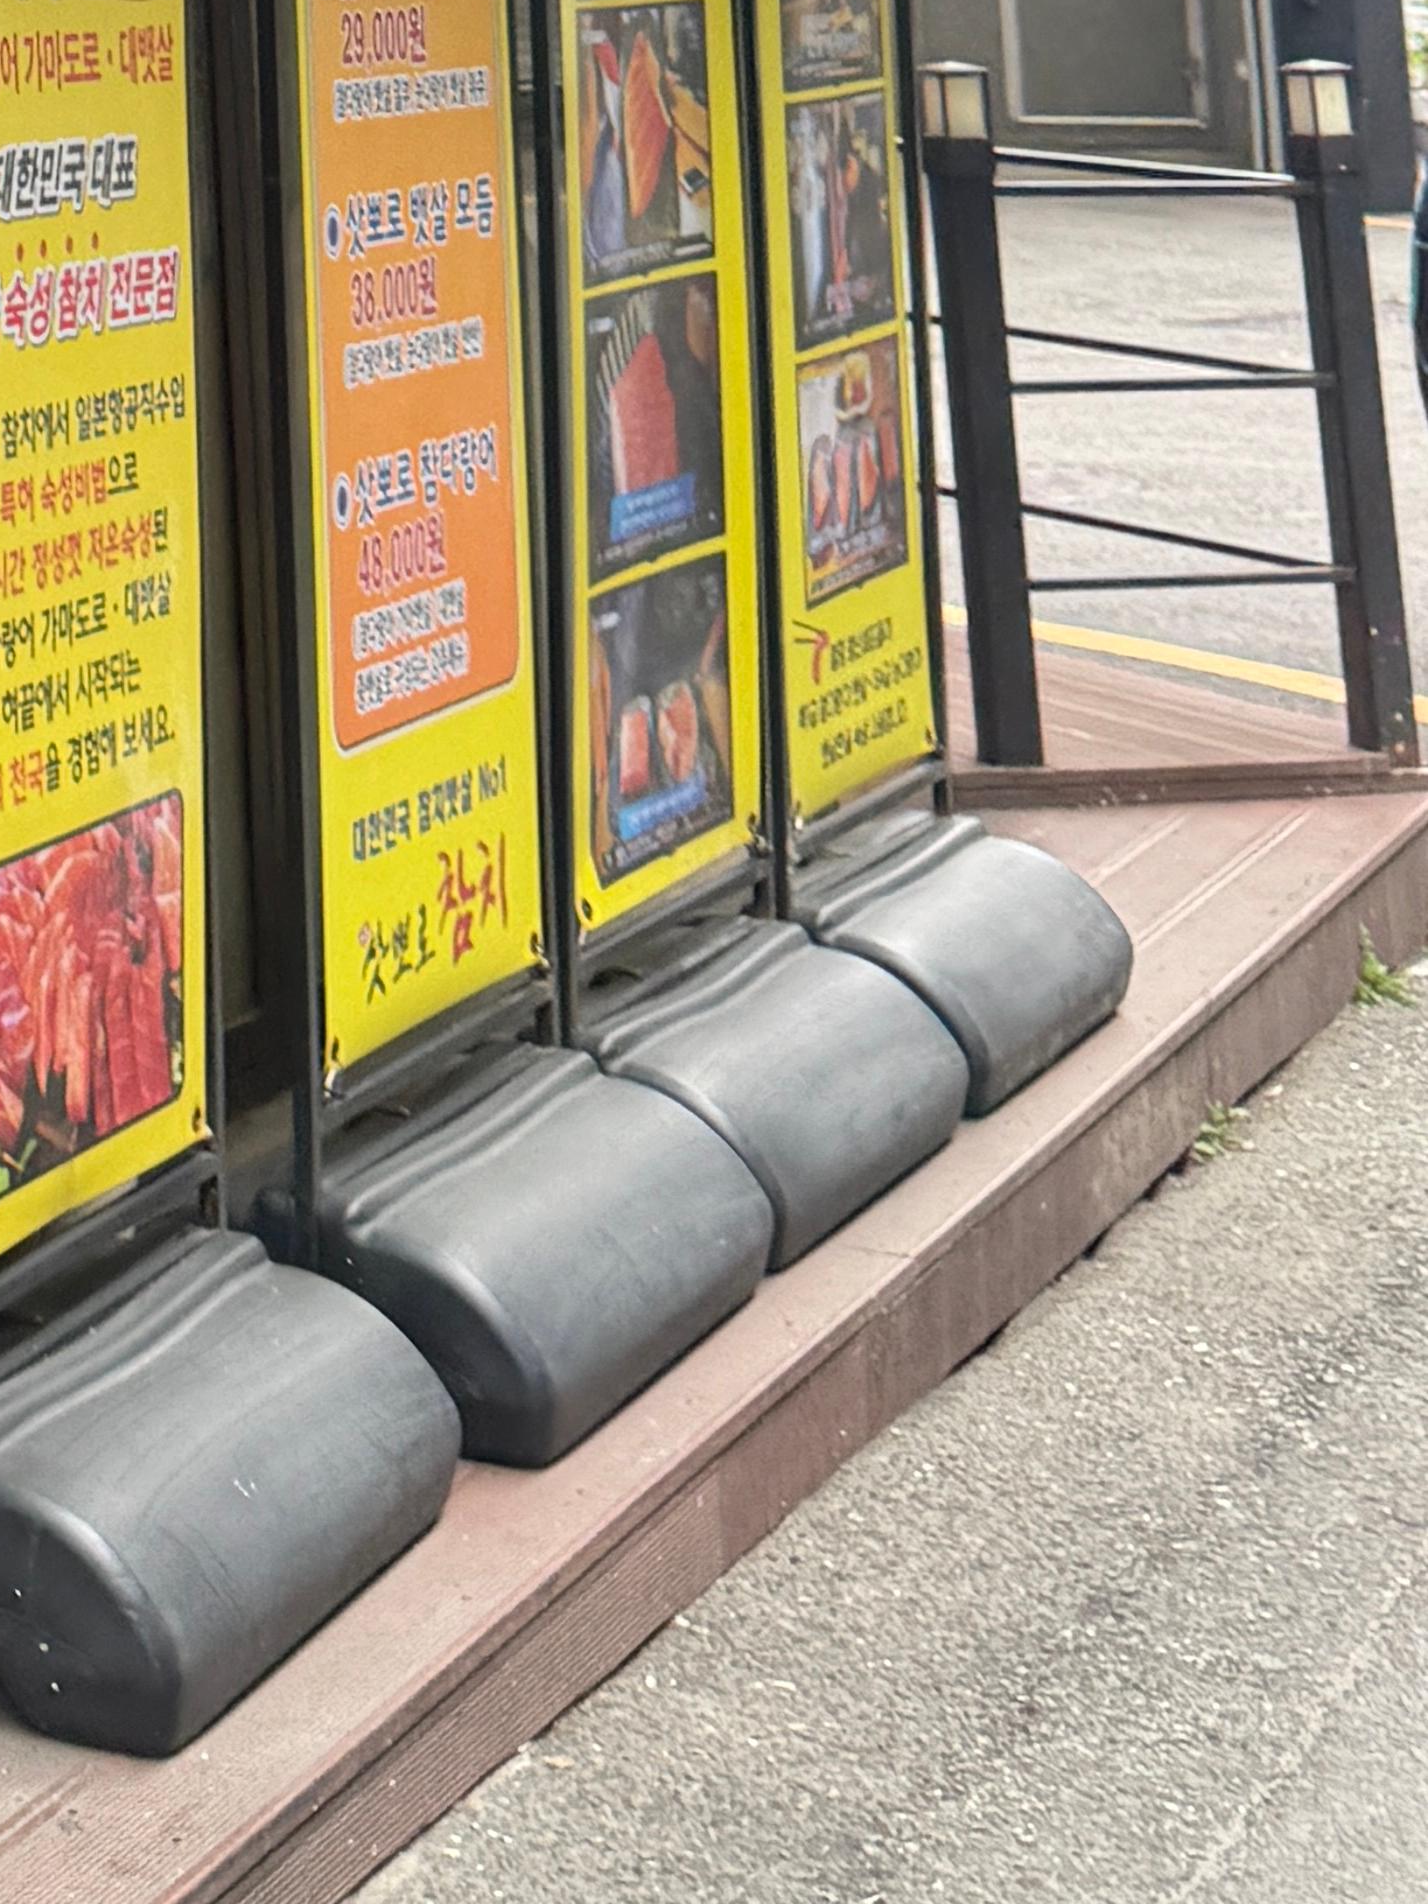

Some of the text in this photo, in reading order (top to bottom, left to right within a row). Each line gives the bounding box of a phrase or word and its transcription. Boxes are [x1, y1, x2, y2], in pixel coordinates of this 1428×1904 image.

[23, 29, 102, 93] 가마도로
[119, 23, 174, 84] 대뱃살
[89, 139, 136, 201] 대표
[455, 177, 494, 241] 모듬
[4, 272, 54, 340] 숙성
[58, 265, 107, 331] 참치
[110, 252, 179, 321] 전문점
[0, 476, 35, 527] 특허
[436, 833, 508, 964] 참치
